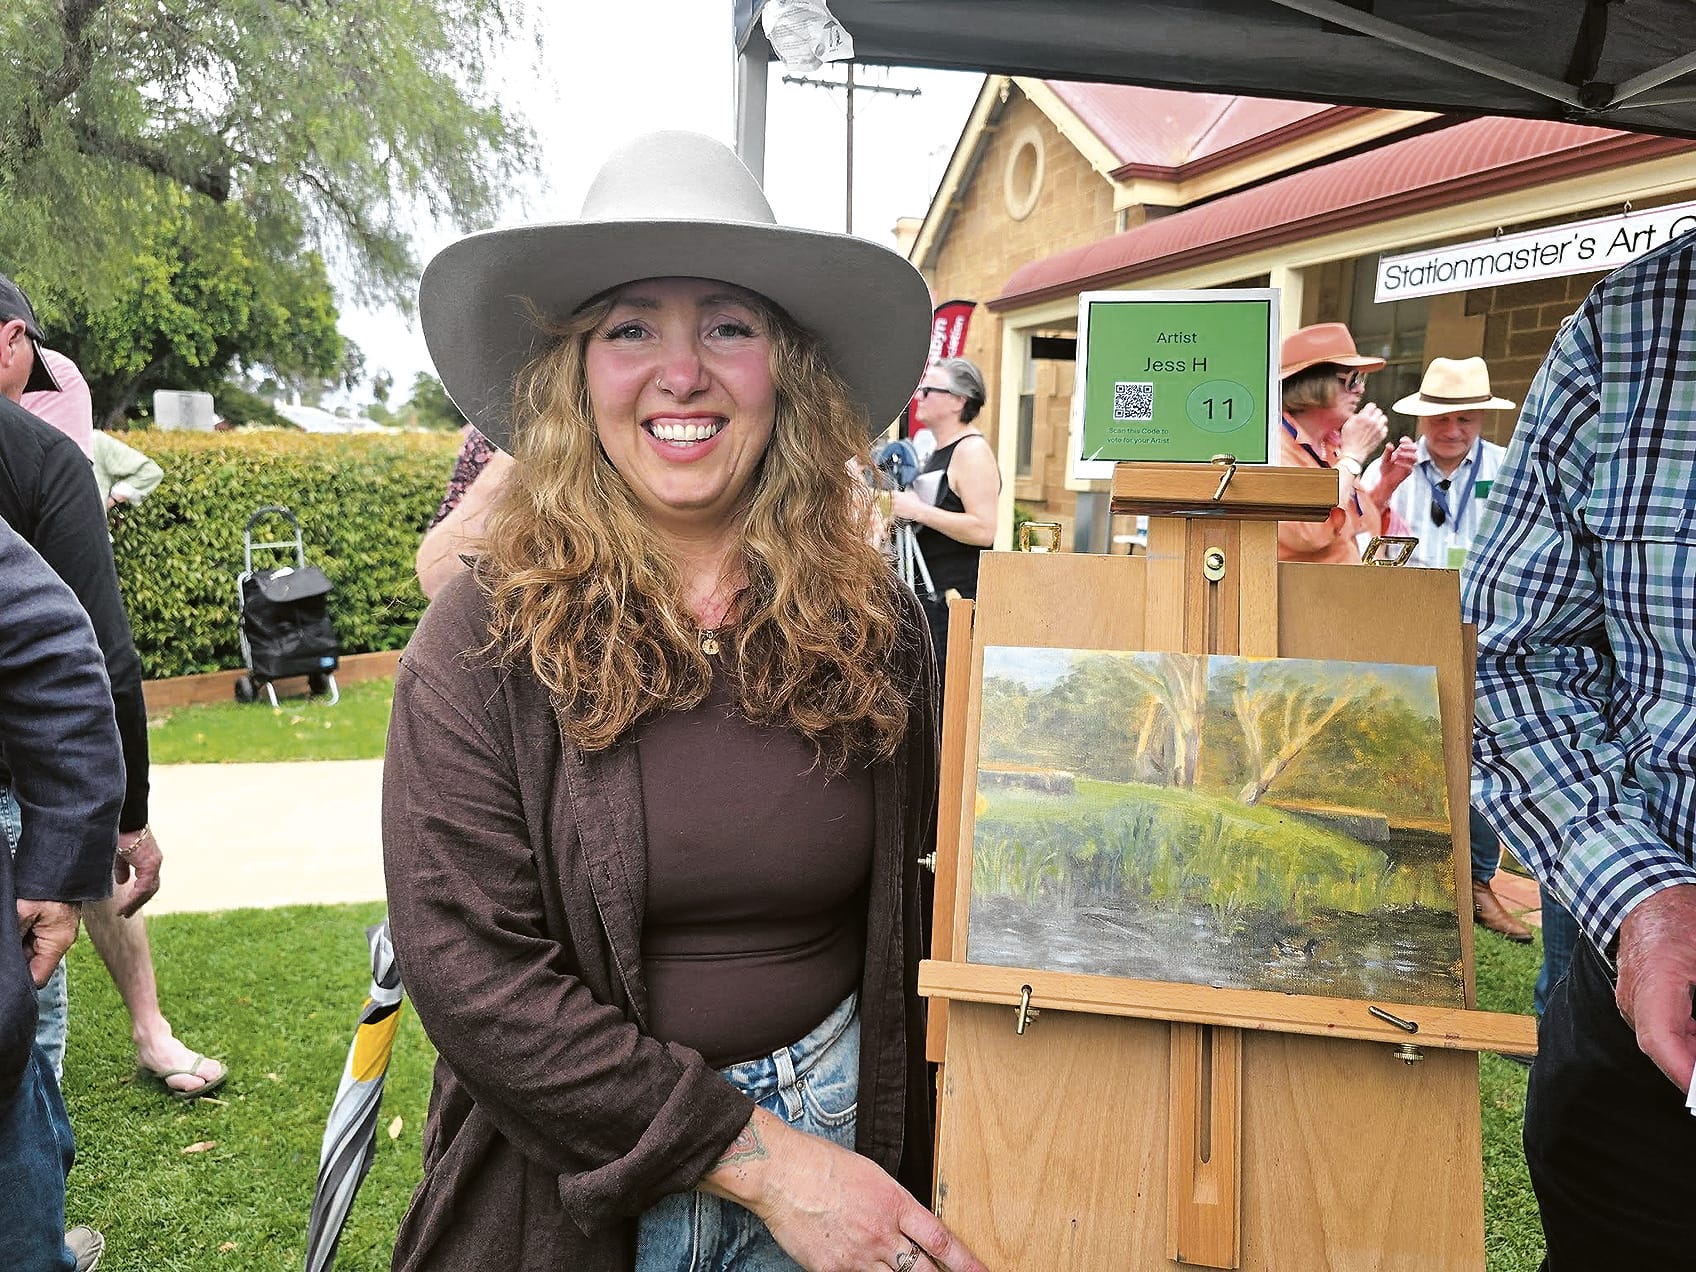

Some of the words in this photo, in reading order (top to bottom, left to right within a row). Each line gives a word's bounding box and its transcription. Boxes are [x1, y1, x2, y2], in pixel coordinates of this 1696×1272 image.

[1384, 234, 1596, 290] Stationmaster's
[1606, 224, 1657, 257] Art
[1156, 331, 1198, 344] Artist
[1143, 357, 1186, 372] Jess
[1192, 357, 1207, 372] H
[1202, 398, 1233, 420] 11
